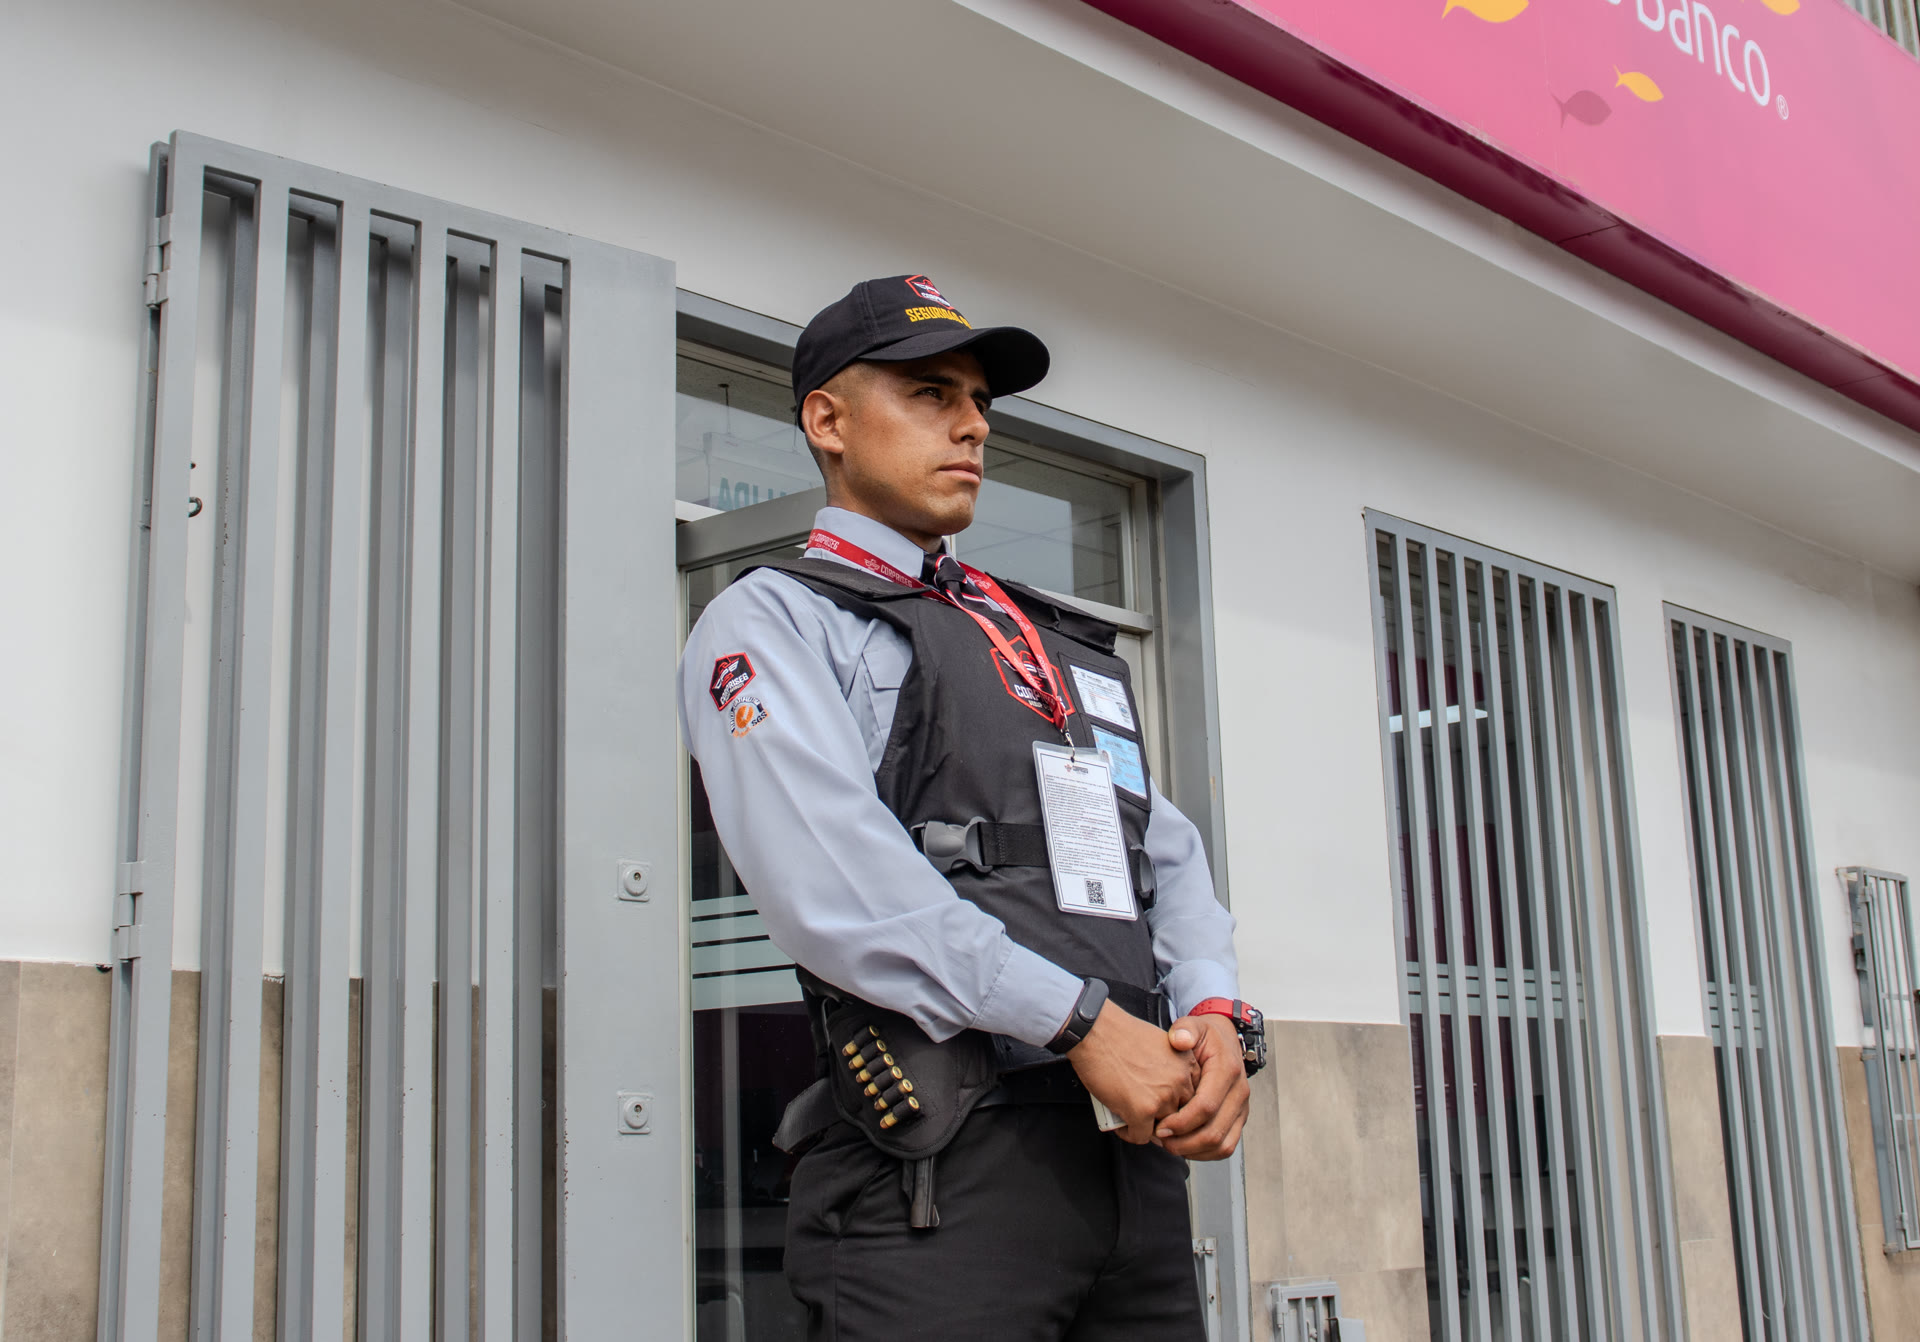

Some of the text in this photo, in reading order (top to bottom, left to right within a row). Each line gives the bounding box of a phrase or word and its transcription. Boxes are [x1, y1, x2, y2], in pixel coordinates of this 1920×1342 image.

[814, 533, 840, 551] CORPRISEG
[880, 564, 913, 588] CORPRISEG
[750, 711, 768, 727] SGS
